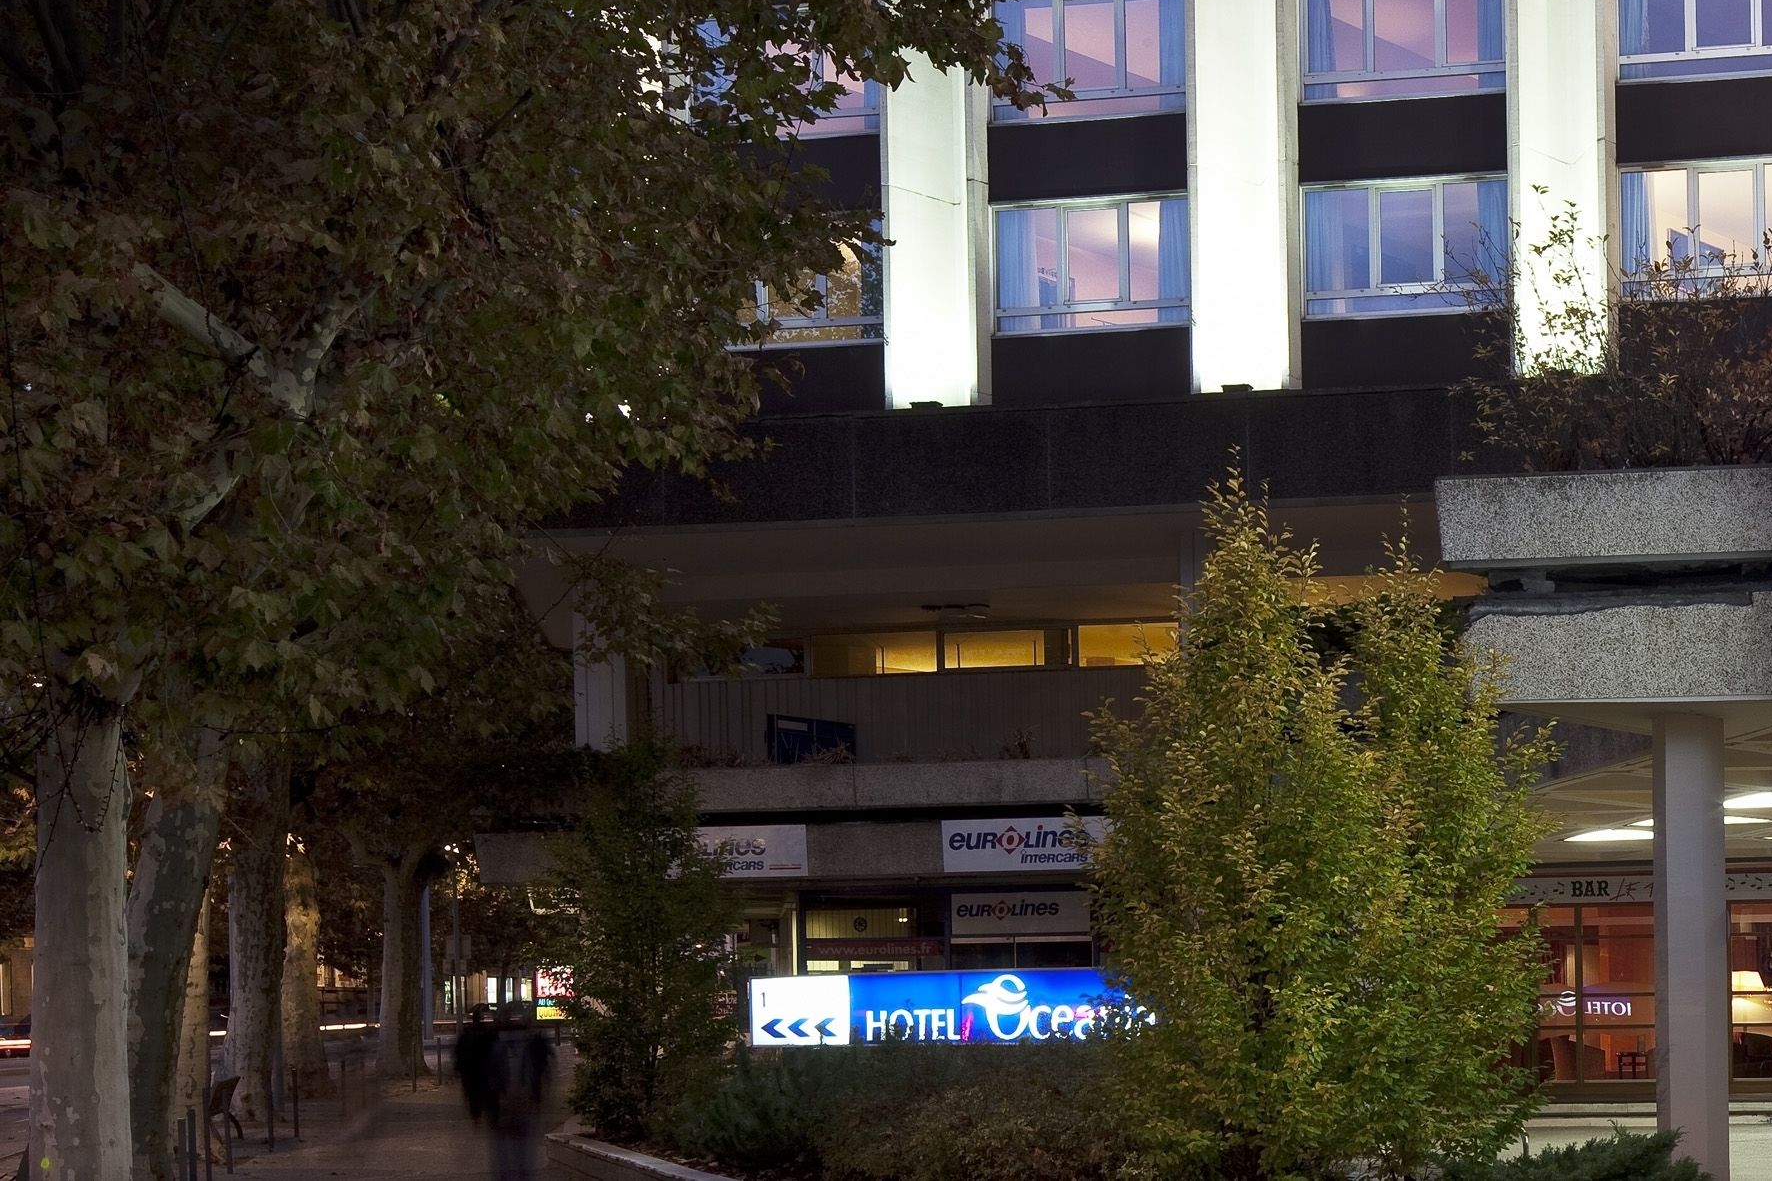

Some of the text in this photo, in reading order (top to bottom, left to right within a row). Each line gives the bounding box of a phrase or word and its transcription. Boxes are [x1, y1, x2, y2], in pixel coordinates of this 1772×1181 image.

[1570, 880, 1610, 898] BAR
[817, 942, 932, 956] www.eurolines.fr
[865, 1008, 961, 1041] HOTEL
